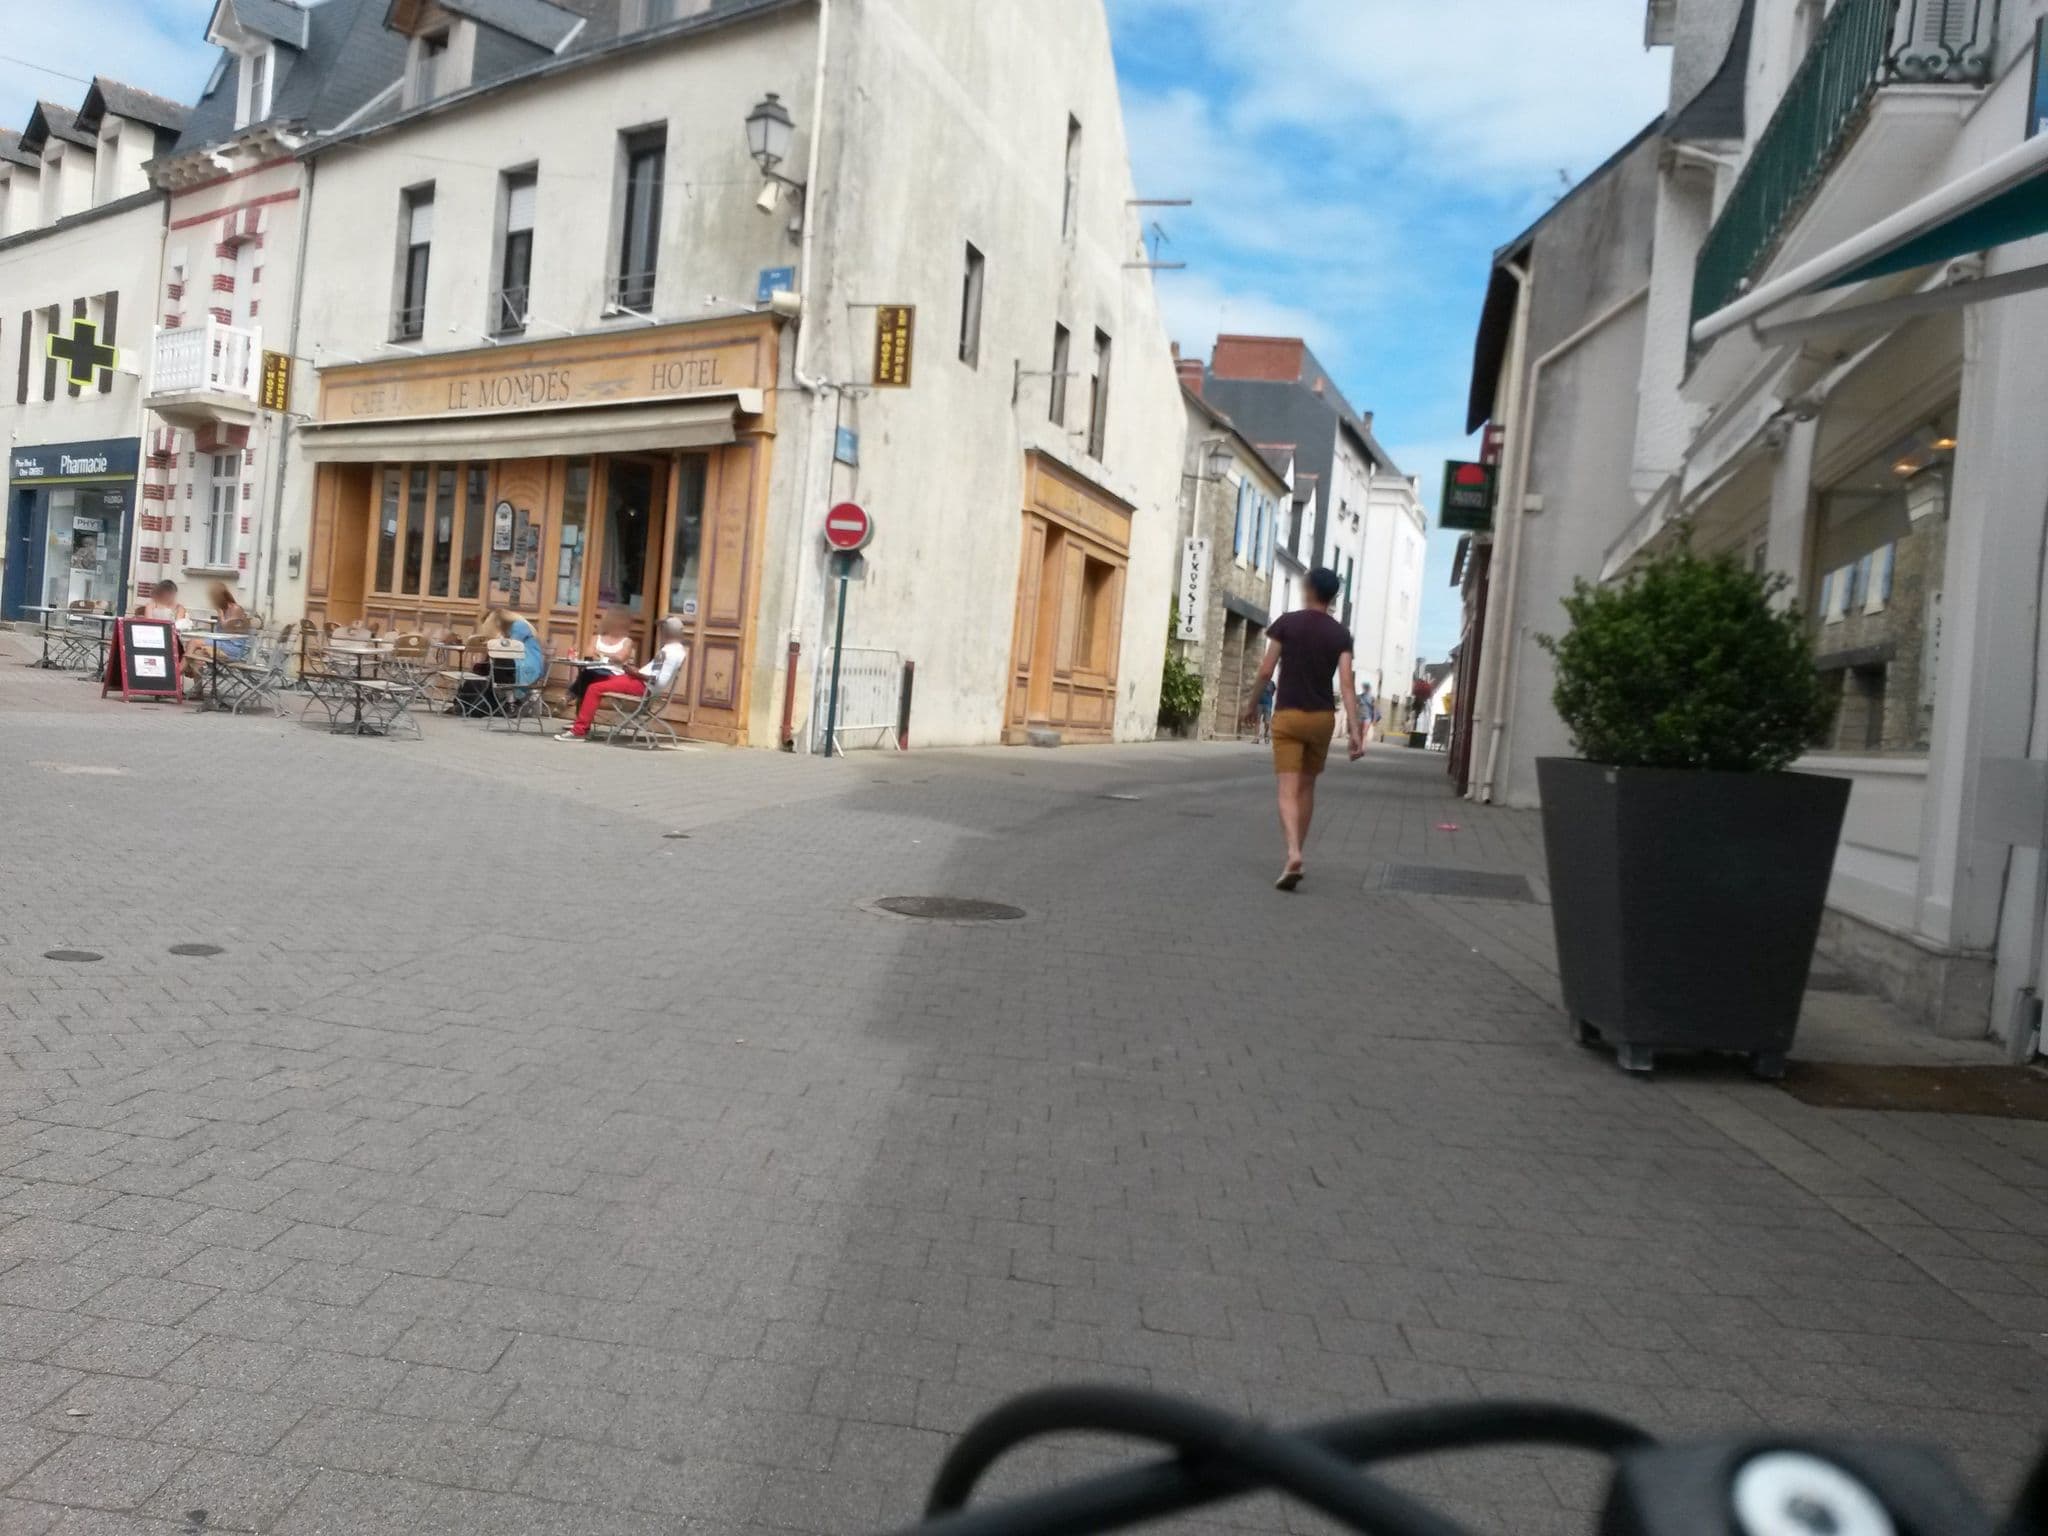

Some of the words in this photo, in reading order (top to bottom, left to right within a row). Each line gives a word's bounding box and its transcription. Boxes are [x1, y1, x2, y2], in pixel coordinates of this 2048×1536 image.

[651, 358, 723, 390] HOTEL
[447, 381, 469, 410] LE
[60, 453, 107, 475] Pharmacie
